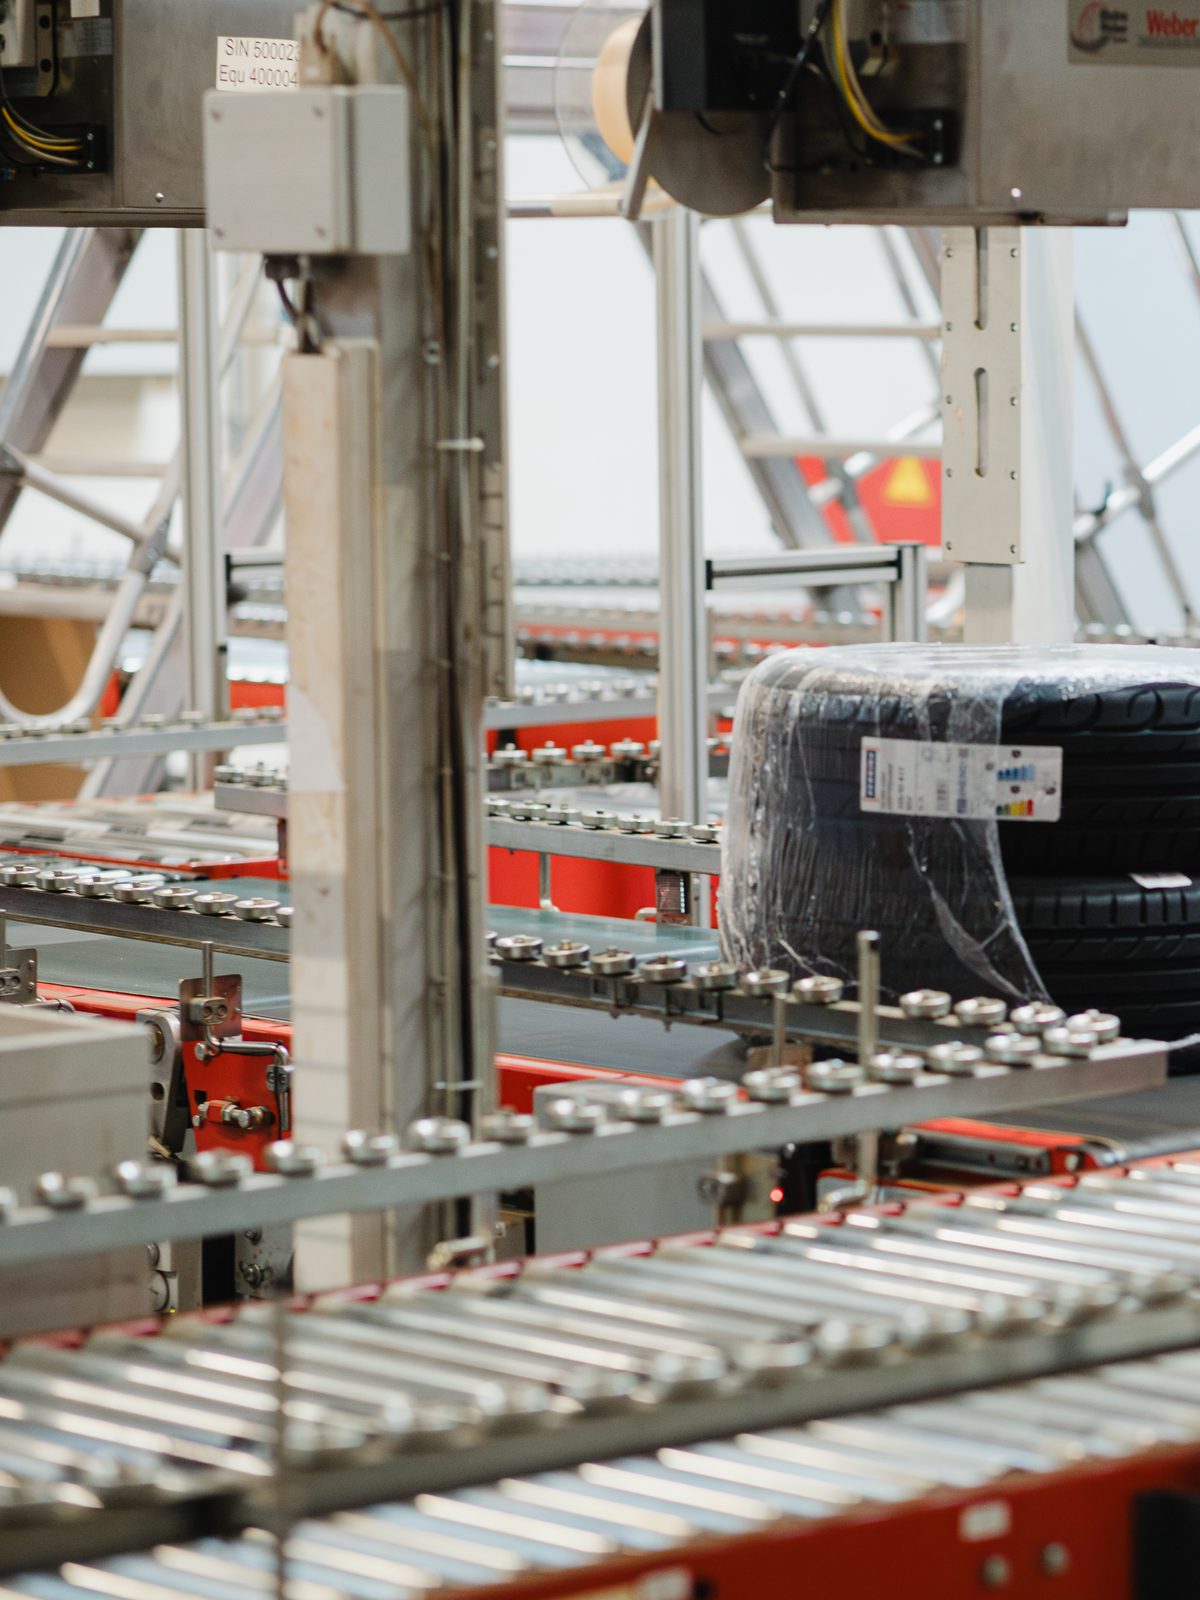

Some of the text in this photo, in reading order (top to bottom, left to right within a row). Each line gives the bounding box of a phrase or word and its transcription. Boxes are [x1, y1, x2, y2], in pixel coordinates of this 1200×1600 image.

[1147, 9, 1199, 37] Weber
[220, 64, 298, 89] Equ 400004
